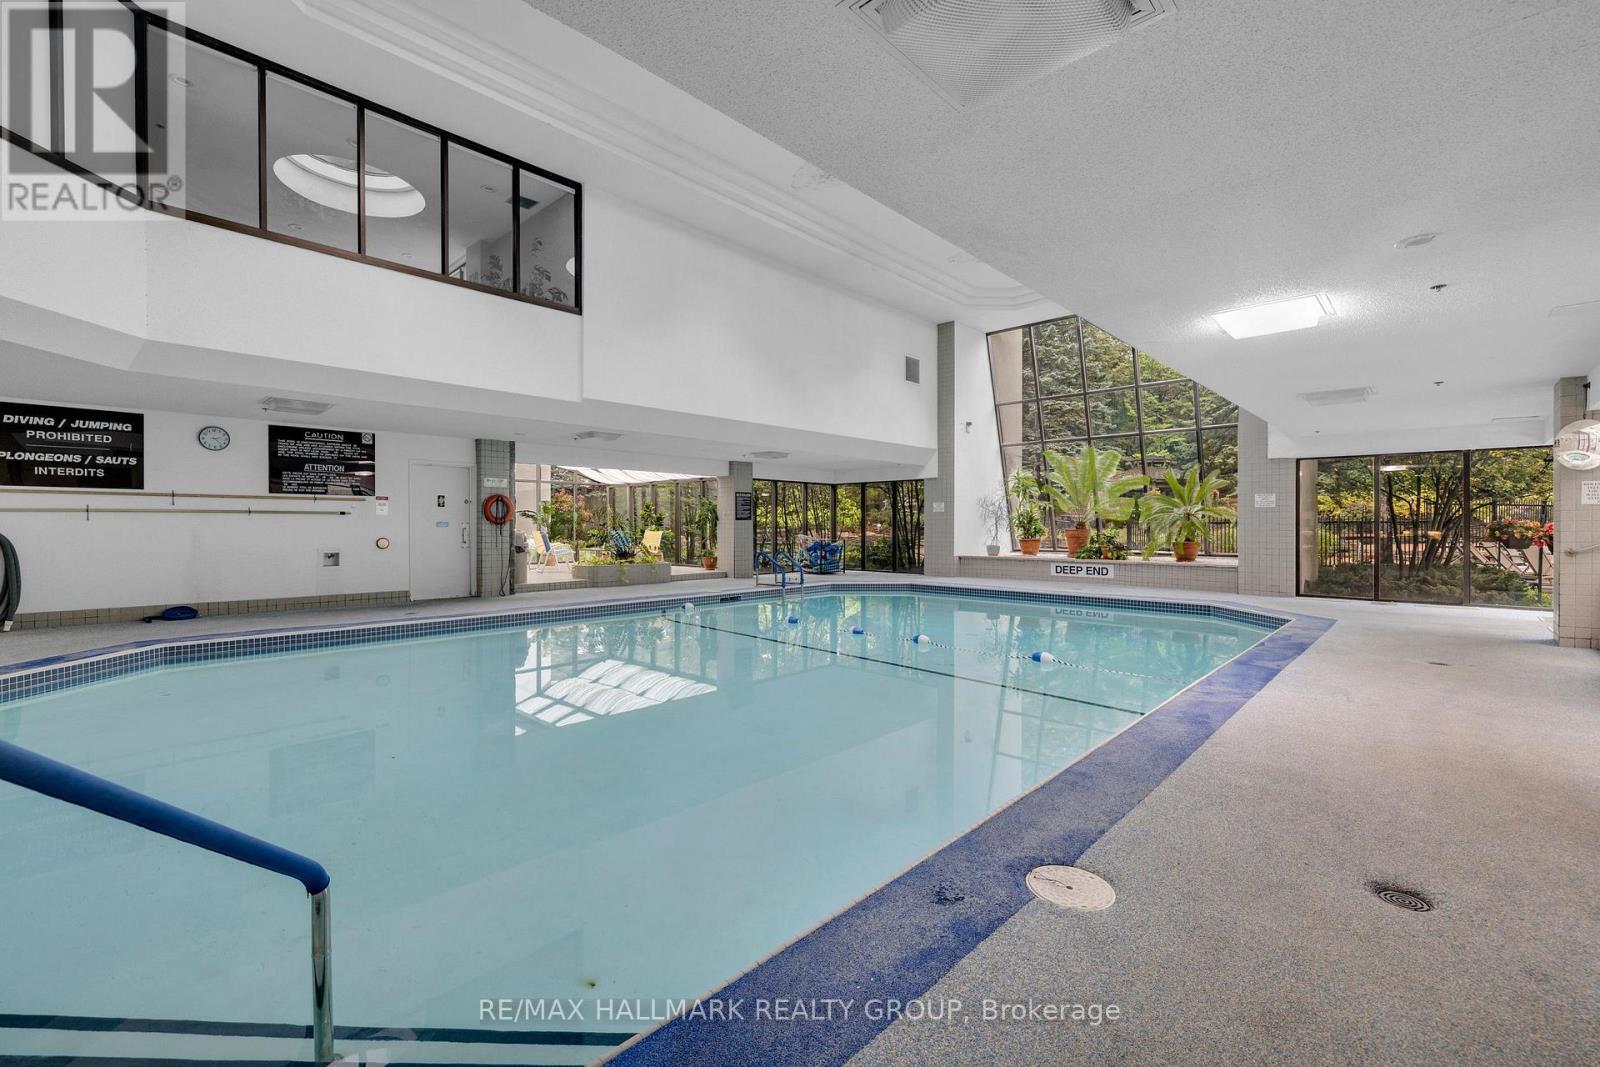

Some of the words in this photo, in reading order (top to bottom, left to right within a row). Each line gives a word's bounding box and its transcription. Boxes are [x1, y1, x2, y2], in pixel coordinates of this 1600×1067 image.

[2, 414, 55, 426] DIVING
[58, 418, 67, 428] /
[70, 419, 133, 432] JUMPING
[26, 430, 113, 443] PROHIBITED
[304, 431, 344, 440] CAUTION
[84, 455, 92, 465] /
[95, 455, 137, 466] SAUTS
[34, 466, 105, 477] INTERDITS
[303, 463, 345, 472] ATTENTION
[1055, 565, 1083, 575] DEEP
[1085, 566, 1109, 576] END
